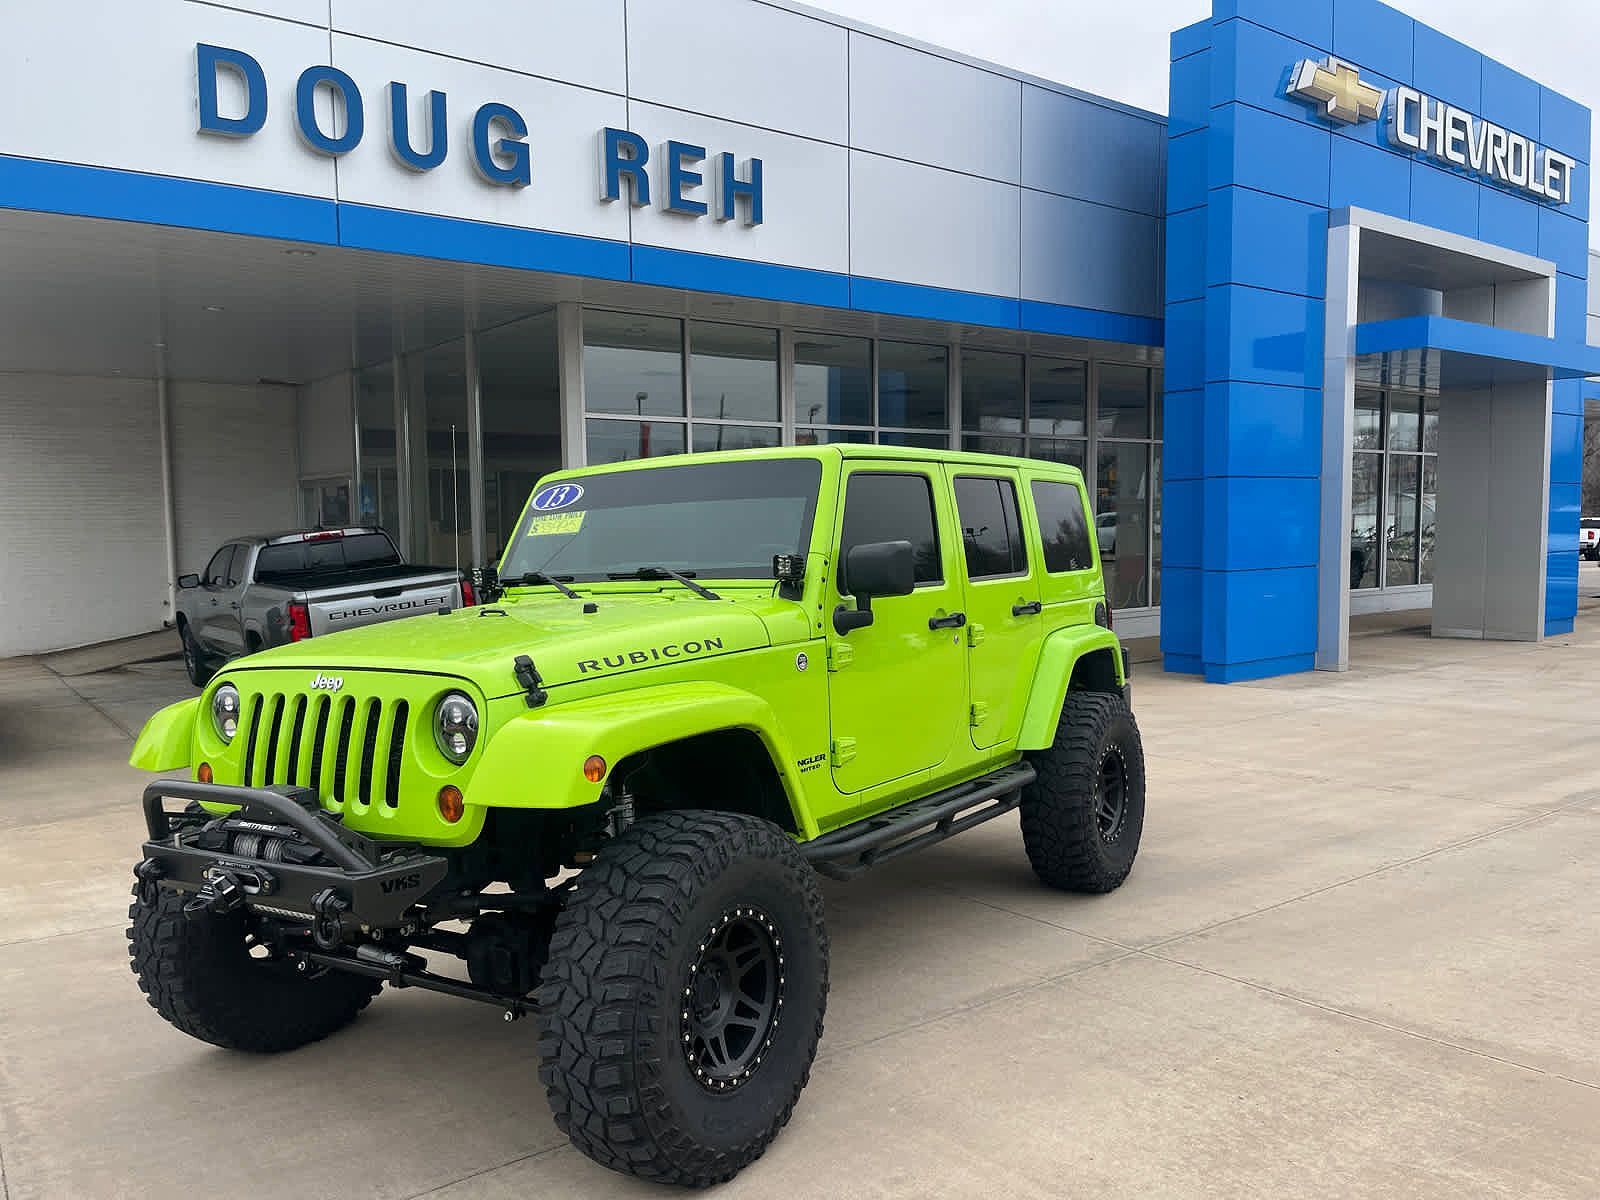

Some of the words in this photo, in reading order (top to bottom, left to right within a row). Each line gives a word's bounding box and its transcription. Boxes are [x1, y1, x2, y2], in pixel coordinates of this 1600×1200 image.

[195, 42, 531, 188] DOUG
[600, 126, 763, 228] REH
[1393, 86, 1576, 205] CHEVROLET
[540, 486, 571, 509] 13
[328, 596, 448, 621] CHEVROLET
[576, 637, 724, 674] RUBICON
[310, 671, 345, 694] Jeep
[796, 753, 827, 767] NGLER
